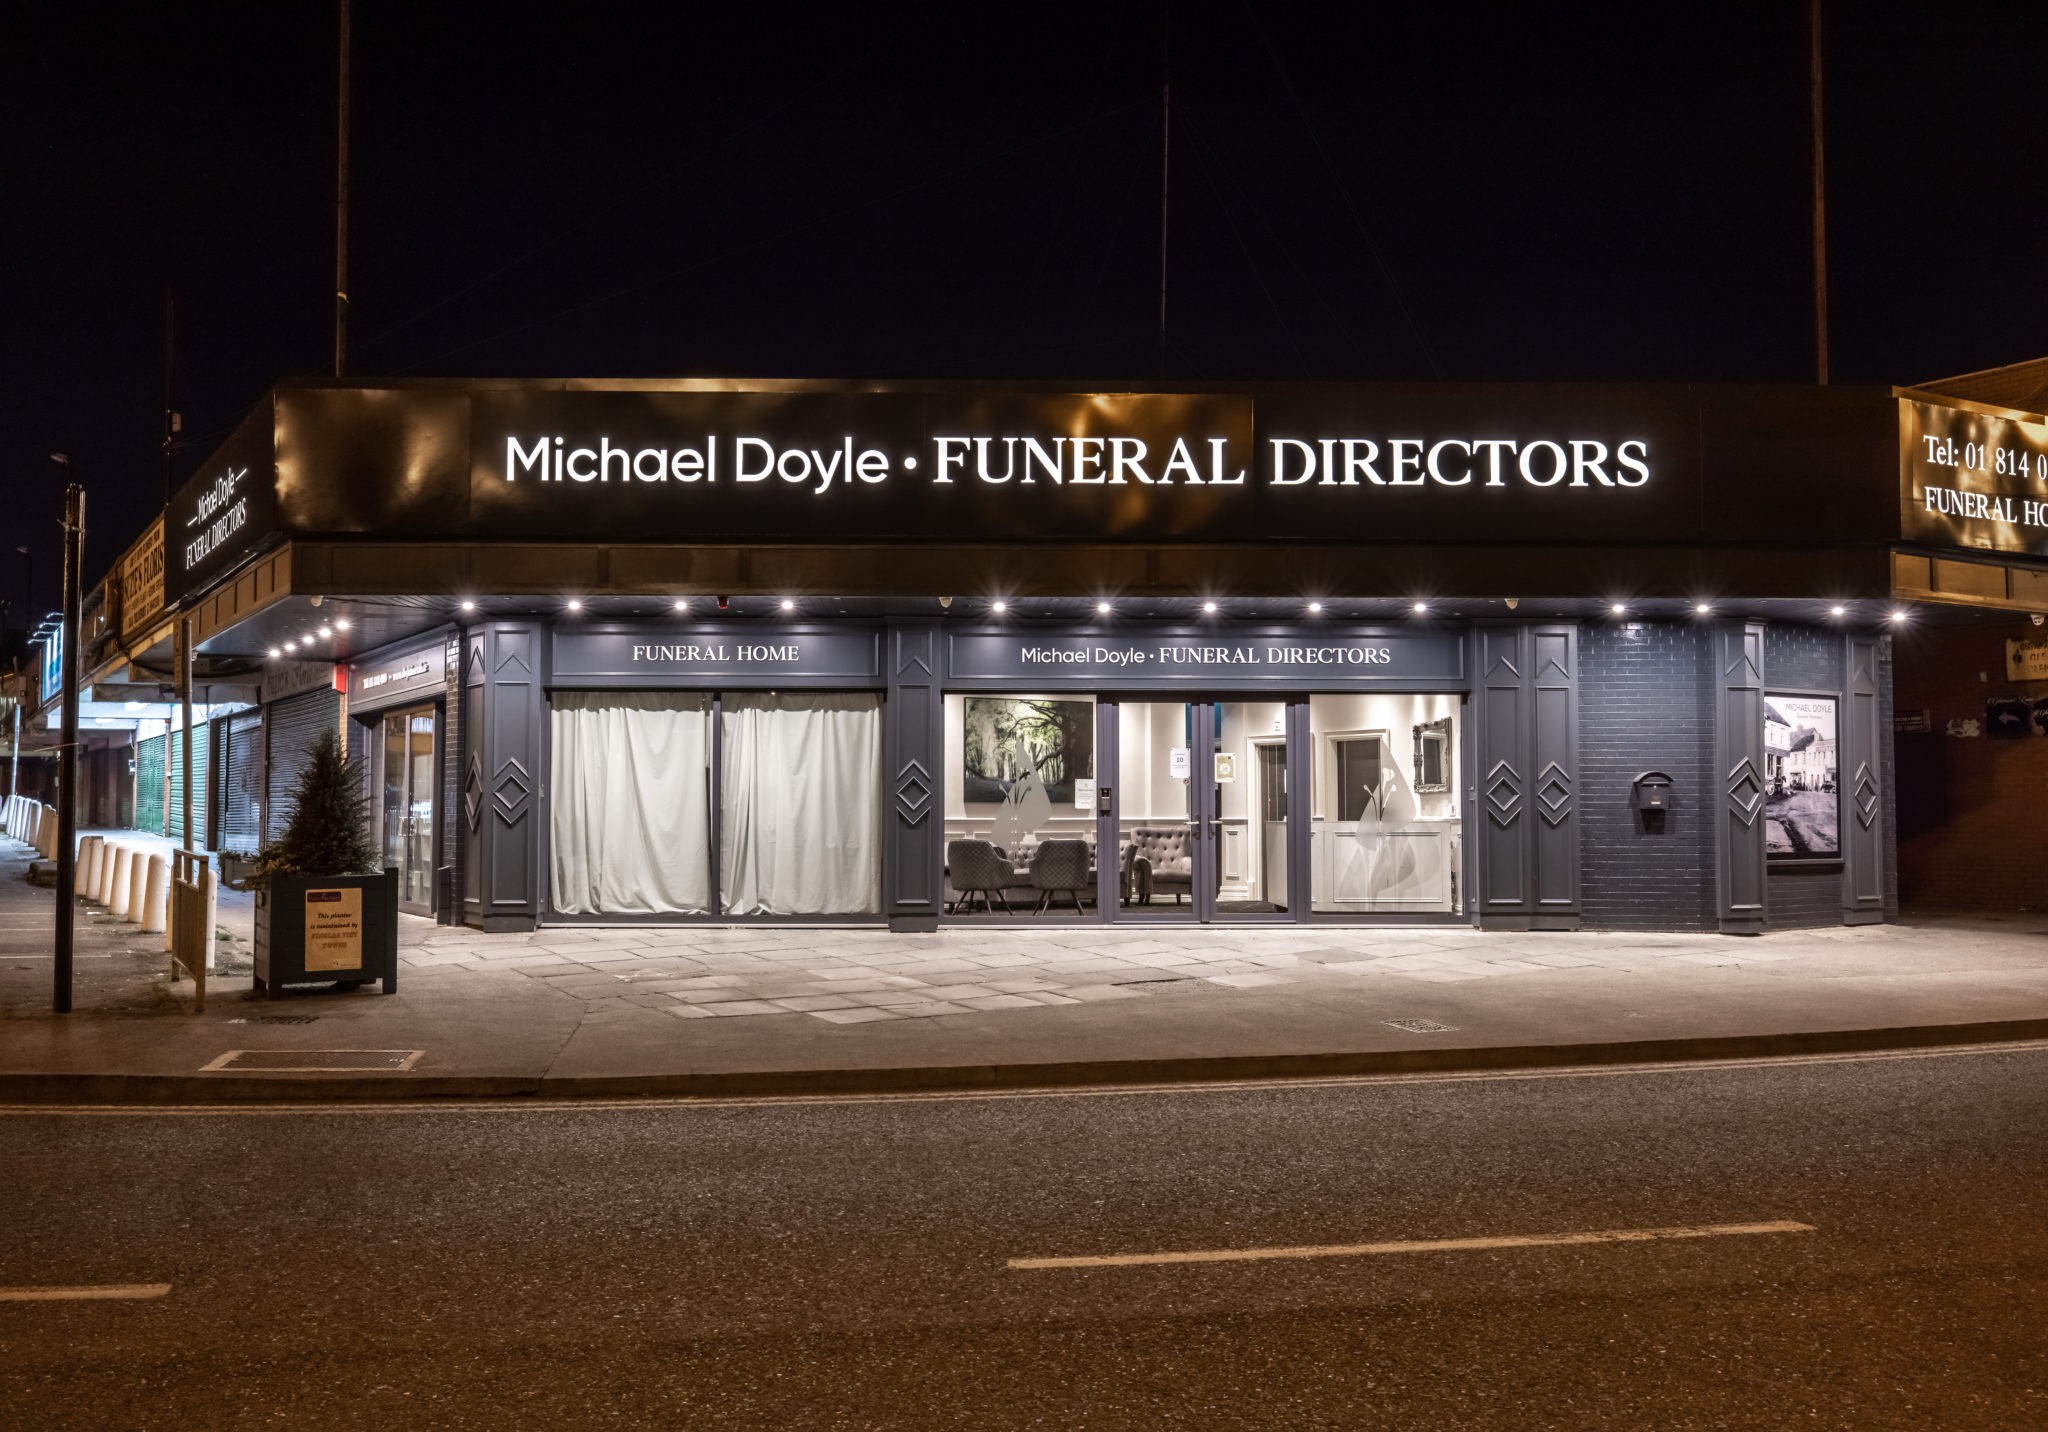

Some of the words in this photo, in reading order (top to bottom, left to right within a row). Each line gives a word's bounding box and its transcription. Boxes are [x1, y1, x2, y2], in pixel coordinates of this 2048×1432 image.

[506, 435, 716, 482] Michael
[736, 436, 889, 495] Doyle
[933, 437, 1245, 485] FUNERAL
[1269, 438, 1650, 487] DIRECTORS
[1923, 434, 1959, 468] Tel:
[1965, 442, 1986, 471] 01
[1995, 447, 2030, 478] 814
[198, 480, 218, 525] Michael
[218, 467, 235, 506] Doyle
[1924, 486, 2018, 523] FUNERAL
[186, 529, 211, 570] FUNERAL
[211, 497, 247, 550] DIRECTORS
[632, 644, 731, 662] FUNERAL
[736, 645, 800, 662] HOME
[1021, 646, 1090, 664] Michael
[1094, 647, 1146, 667] Doyle
[1159, 646, 1261, 664] FUNERAL
[1266, 647, 1391, 664] DIRECTORS
